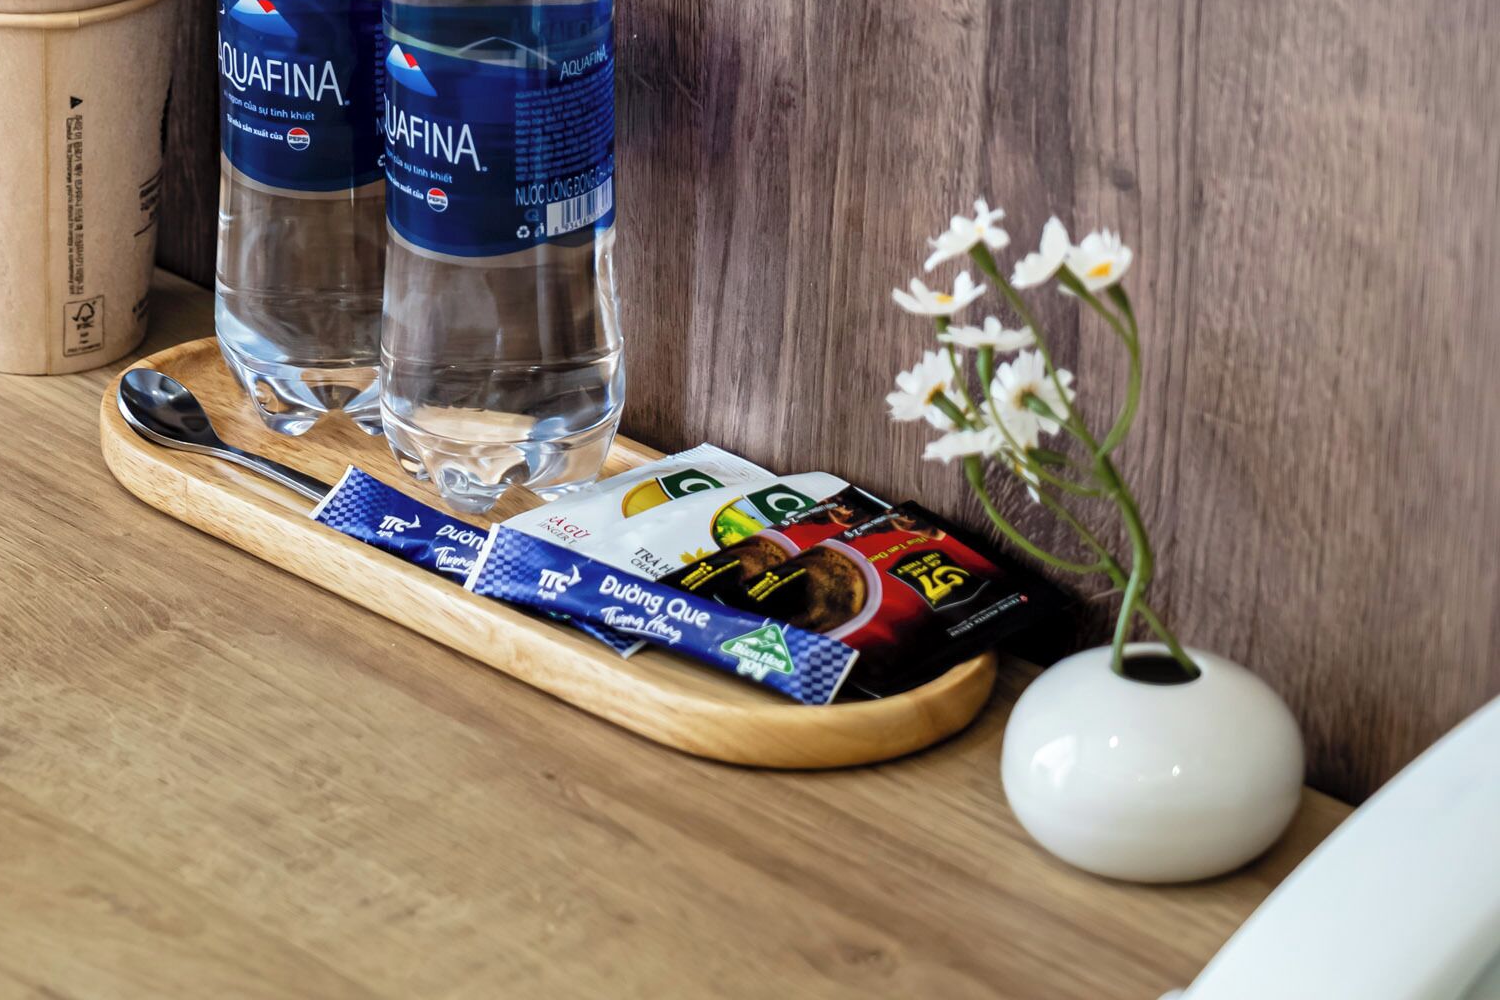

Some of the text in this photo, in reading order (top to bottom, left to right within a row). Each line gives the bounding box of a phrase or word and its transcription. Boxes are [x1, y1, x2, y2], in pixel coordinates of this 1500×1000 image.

[560, 44, 608, 81] AQUAFINA
[243, 98, 257, 112] của
[258, 104, 269, 116] sự
[270, 108, 288, 120] tinh
[290, 111, 316, 122] khiết
[253, 126, 269, 139] xuất
[269, 130, 284, 141] của
[287, 135, 310, 144] PEPSI
[413, 166, 429, 179] tinh
[430, 170, 453, 184] khiết
[436, 524, 486, 550] Đườn
[564, 523, 591, 540] GỪ
[634, 547, 662, 567] TRÀ
[918, 565, 970, 601] G7
[599, 574, 665, 615] Đường
[666, 598, 711, 629] Que
